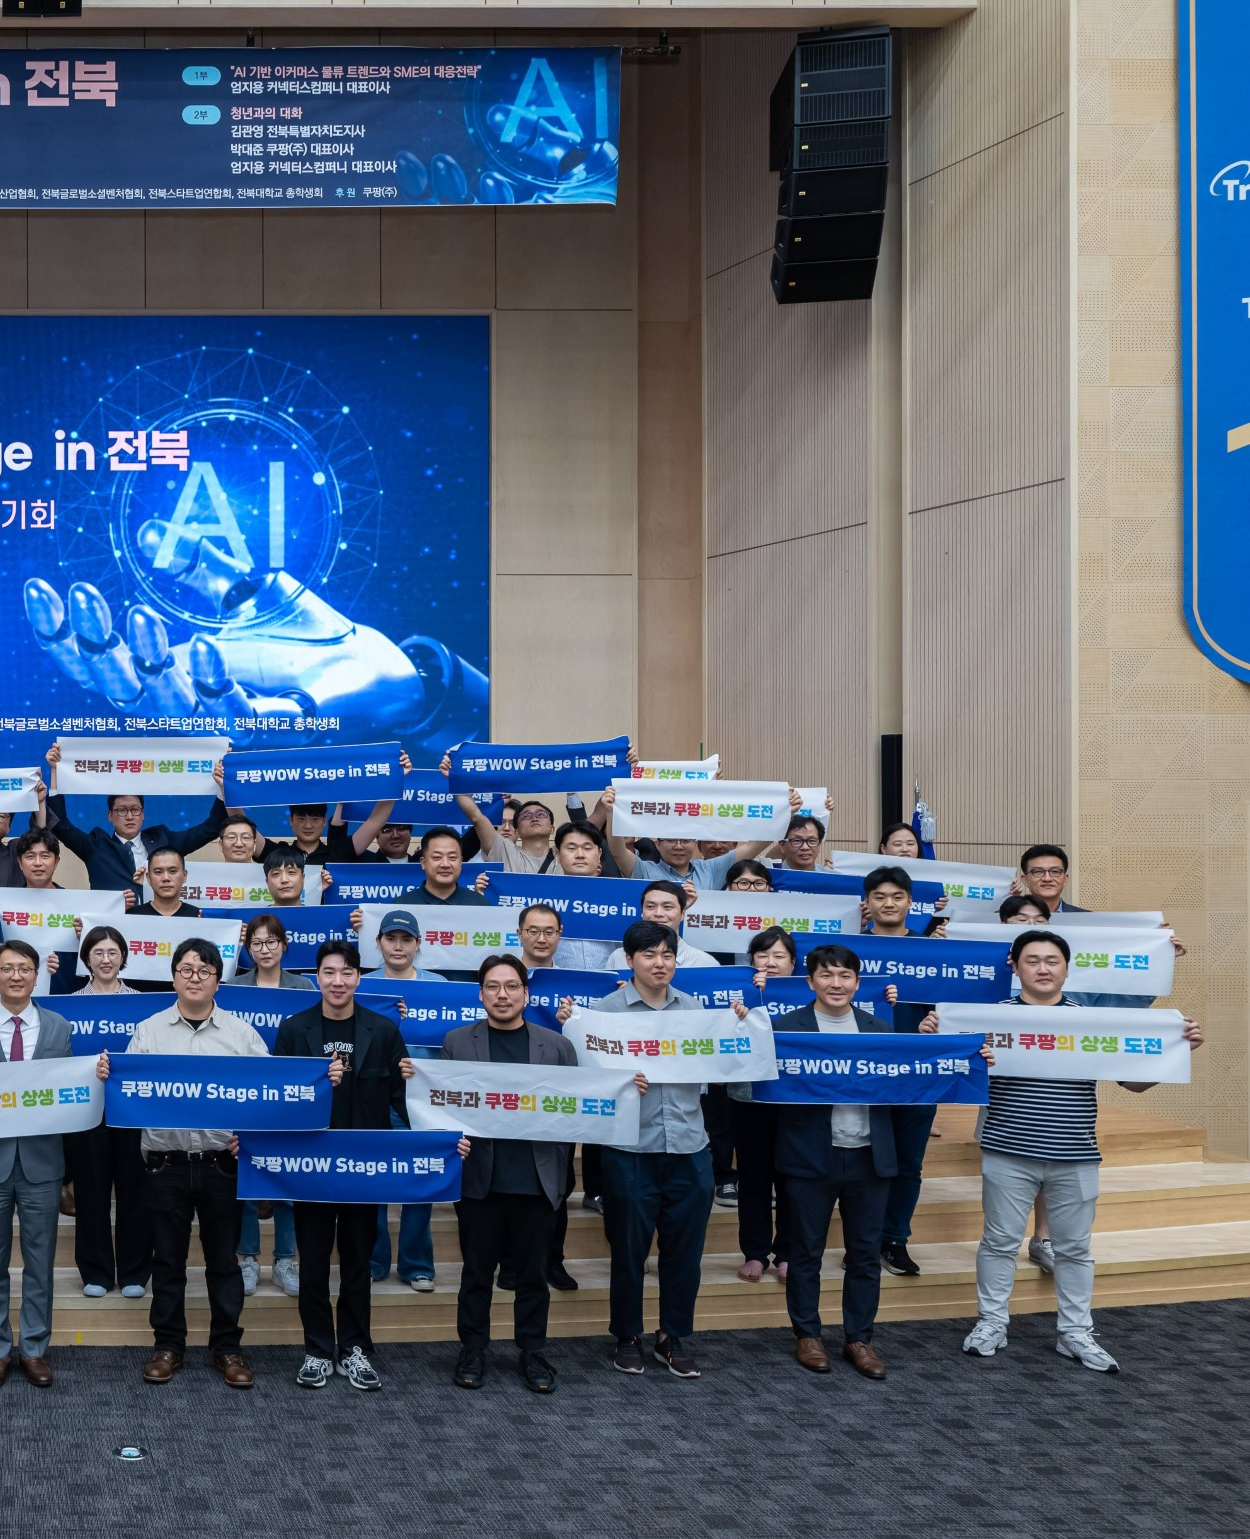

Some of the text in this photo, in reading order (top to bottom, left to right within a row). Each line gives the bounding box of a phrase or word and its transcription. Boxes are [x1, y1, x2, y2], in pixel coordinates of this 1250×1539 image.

[195, 72, 208, 80] 1부
[250, 66, 272, 78] 기반
[275, 66, 319, 78] 이커머스
[322, 66, 344, 78] 물류
[347, 66, 391, 78] 트렌드와
[394, 66, 430, 78] SME의
[25, 61, 118, 107] 전북
[231, 81, 390, 94] 엄지용 커넥터스컴퍼니 대표이사
[194, 111, 208, 120] 2부
[231, 107, 302, 120] 청년과의 대화
[231, 125, 365, 138] 김관영 전북특별자치도지사
[231, 143, 354, 156] 박대준 쿠팡(주) 대표이사
[231, 161, 397, 174] 엄지용 커넥터스컴퍼니 대표이사
[55, 430, 95, 470] in
[108, 431, 190, 472] 전북
[2, 499, 56, 529] 기회
[152, 462, 284, 568] AI
[124, 717, 230, 731] 전북스타트업연합회,
[234, 718, 290, 730] 전북대학교
[294, 717, 339, 730] 총학생회
[75, 760, 213, 773] 전북과 쿠팡의 상생 도전
[530, 758, 571, 771] Stage
[575, 756, 588, 768] in
[592, 755, 617, 768] 전북
[631, 802, 773, 818] 전북과 쿠팡의 상생 도전
[585, 1034, 751, 1056] 전북과 쿠팡의 상생 도전
[1019, 1034, 1162, 1054] 쿠팡의 상생 도전
[857, 1059, 970, 1077] Stage in 전북
[21, 1089, 54, 1107] 상생
[59, 1086, 90, 1104] 도전
[207, 1084, 258, 1102] Stage
[263, 1085, 278, 1100] in
[284, 1085, 315, 1101] 전북
[430, 1089, 616, 1116] 전북과 쿠팡의 상생 도전
[336, 1158, 387, 1175] Stage
[393, 1158, 408, 1173] in
[413, 1158, 444, 1174] 전북
